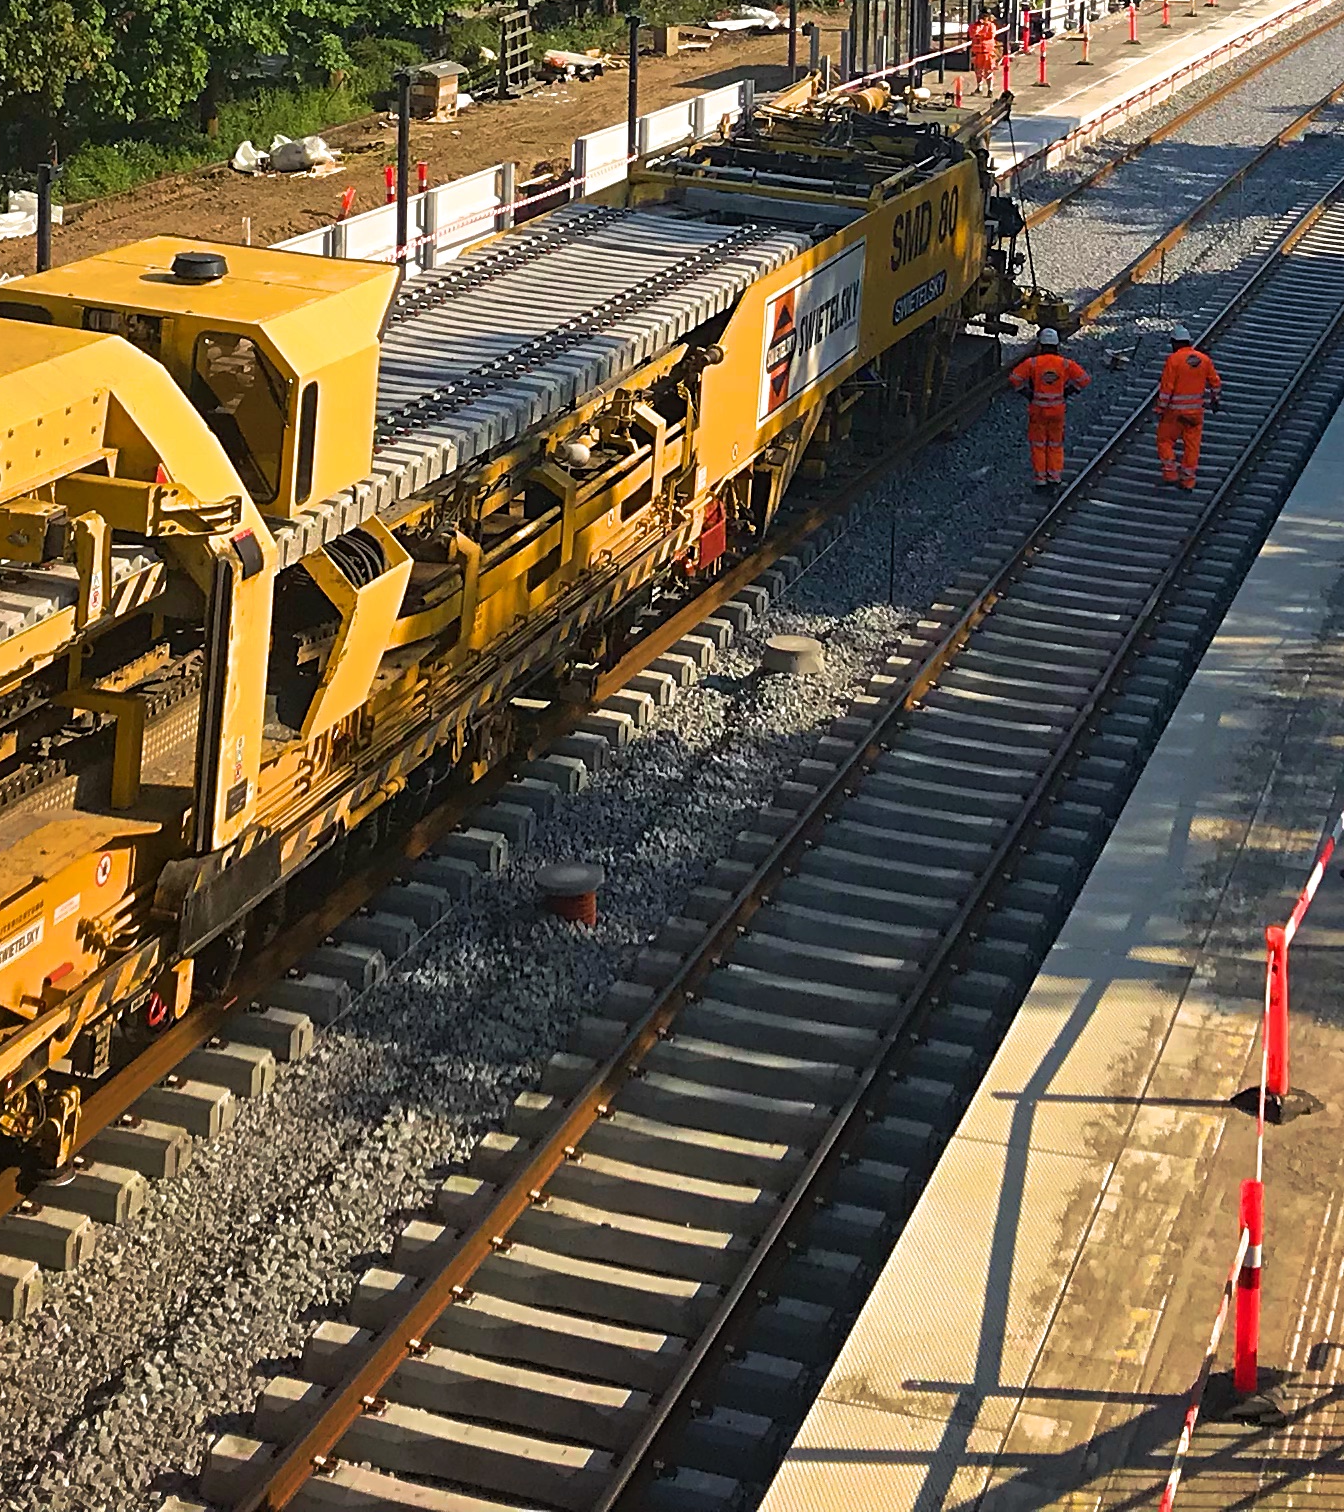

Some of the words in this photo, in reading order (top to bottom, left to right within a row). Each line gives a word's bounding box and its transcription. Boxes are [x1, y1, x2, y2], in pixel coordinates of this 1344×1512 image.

[890, 199, 933, 272] SMD
[938, 185, 959, 244] 80
[798, 278, 860, 357] SWIETELSKY
